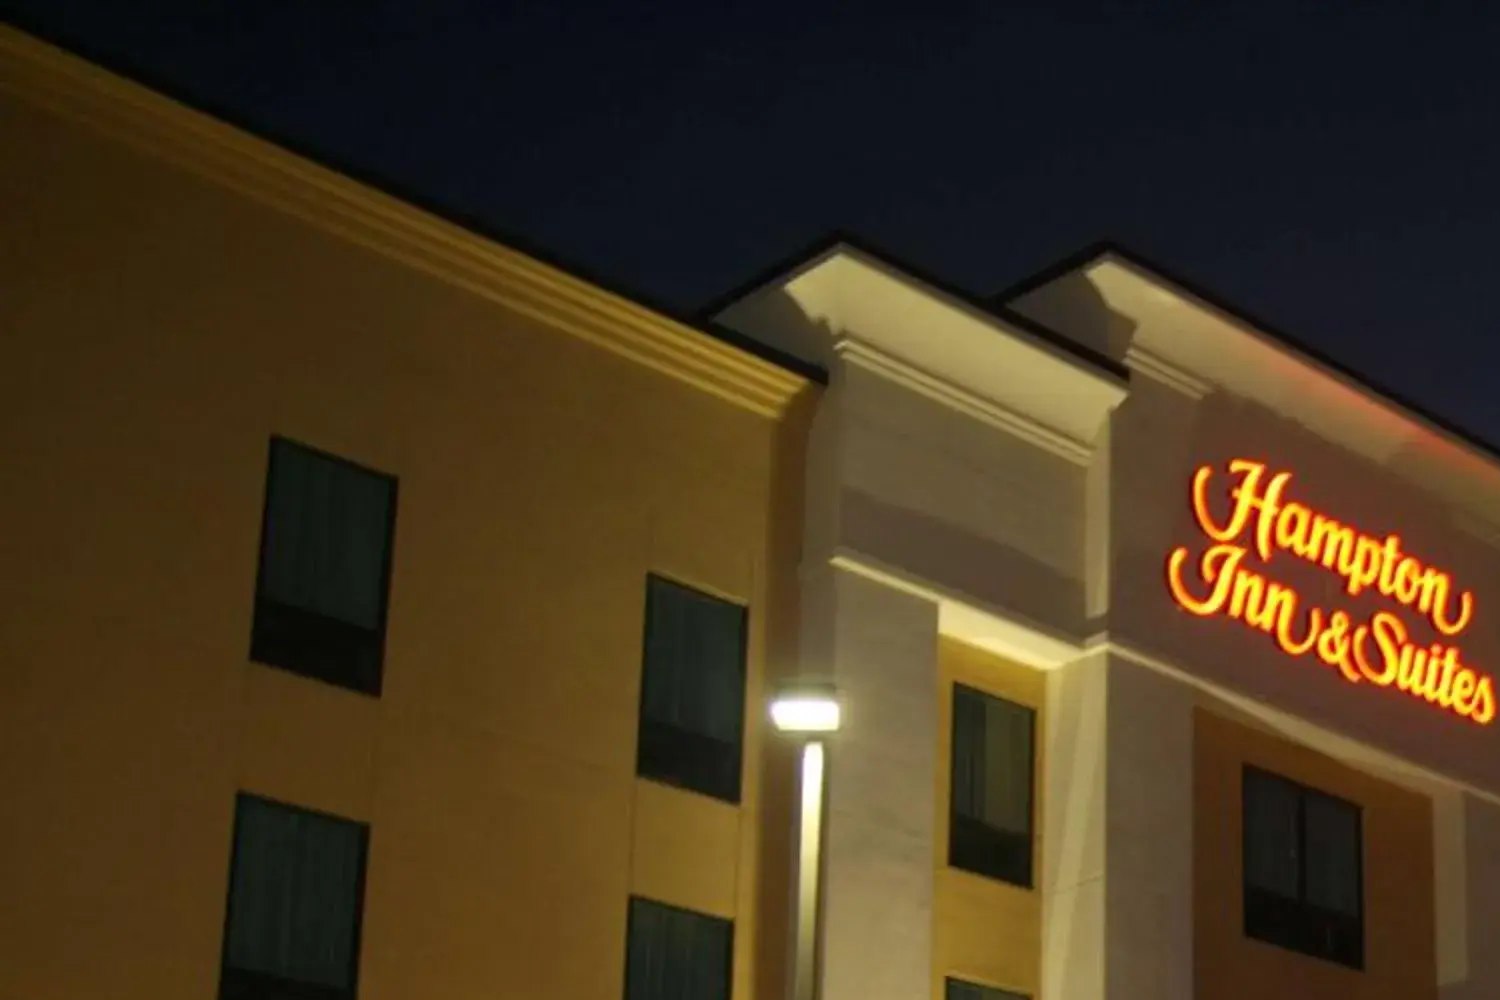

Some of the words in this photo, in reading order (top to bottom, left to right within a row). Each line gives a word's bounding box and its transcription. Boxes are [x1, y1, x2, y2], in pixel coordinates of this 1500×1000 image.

[1168, 545, 1323, 656] Inn
[1317, 610, 1362, 683] &
[1353, 611, 1497, 725] Suites
[1192, 458, 1473, 636] Hampton
